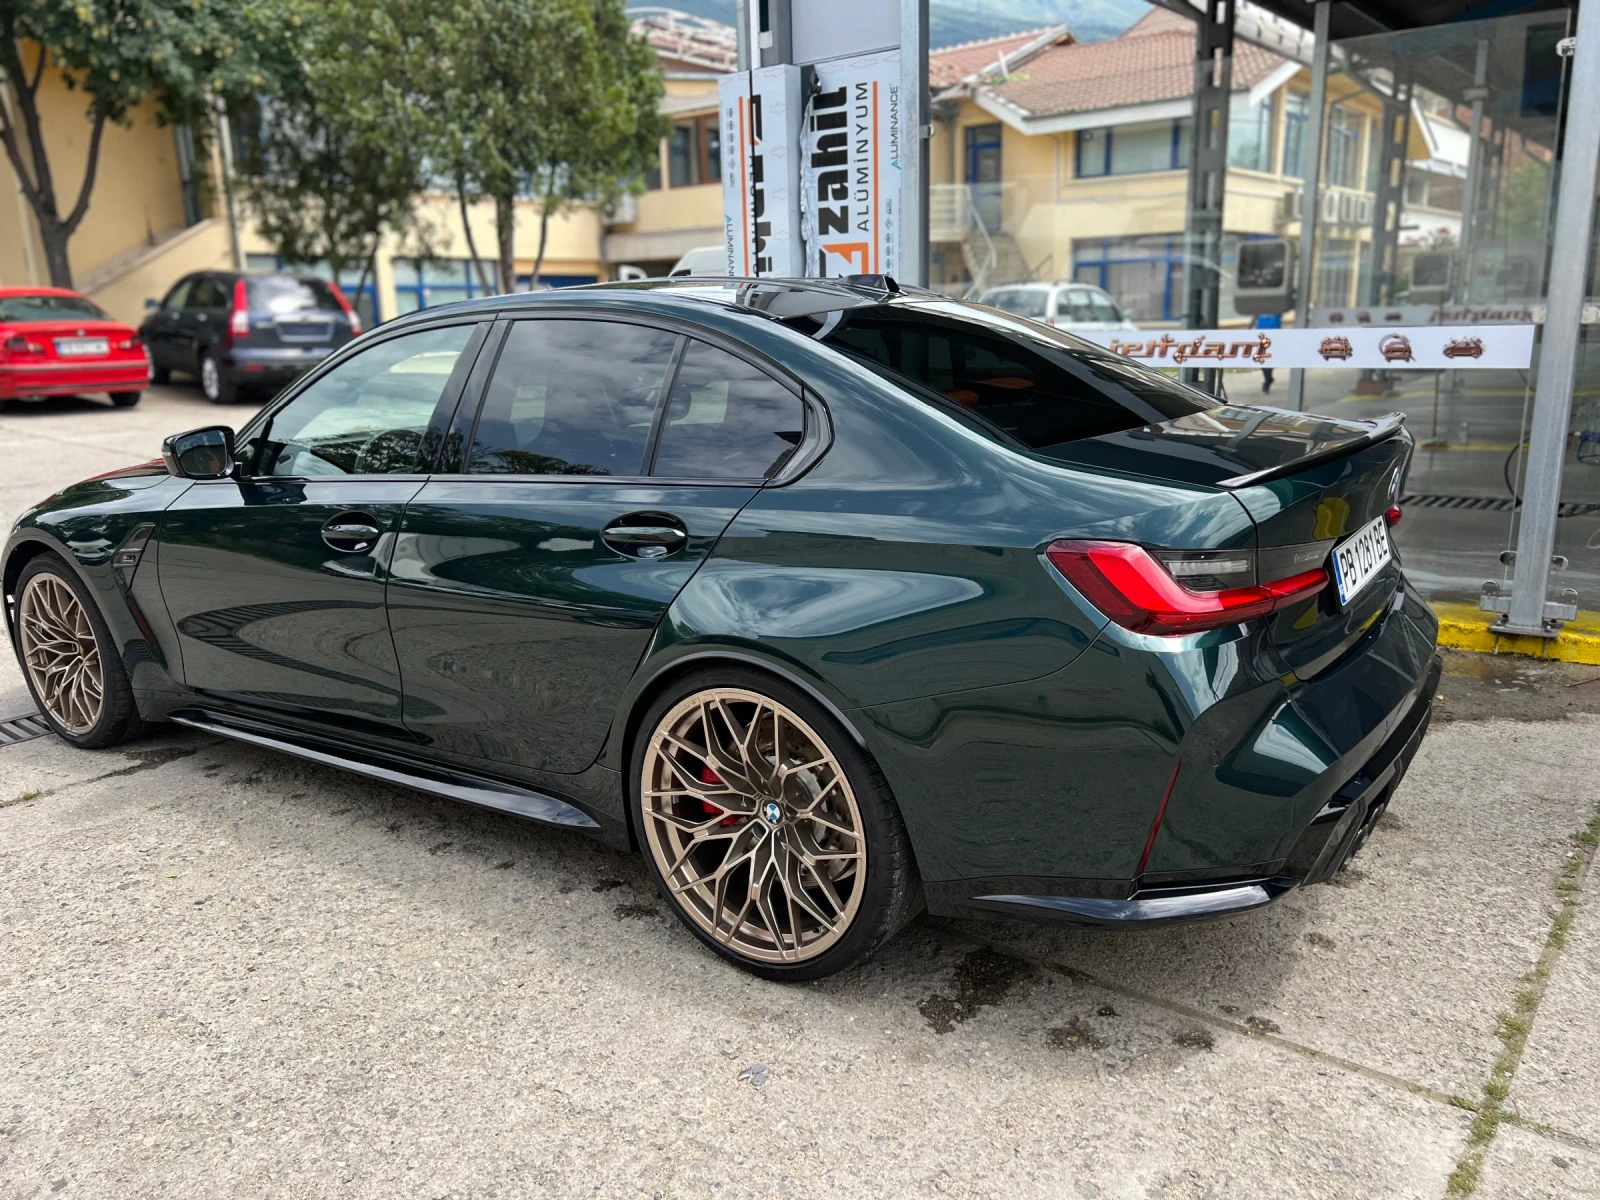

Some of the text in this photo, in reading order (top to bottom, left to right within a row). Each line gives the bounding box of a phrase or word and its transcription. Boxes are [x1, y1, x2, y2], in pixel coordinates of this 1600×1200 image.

[854, 82, 869, 232] ALÜMİNYUM
[1339, 520, 1388, 592] PB 1281 BE
